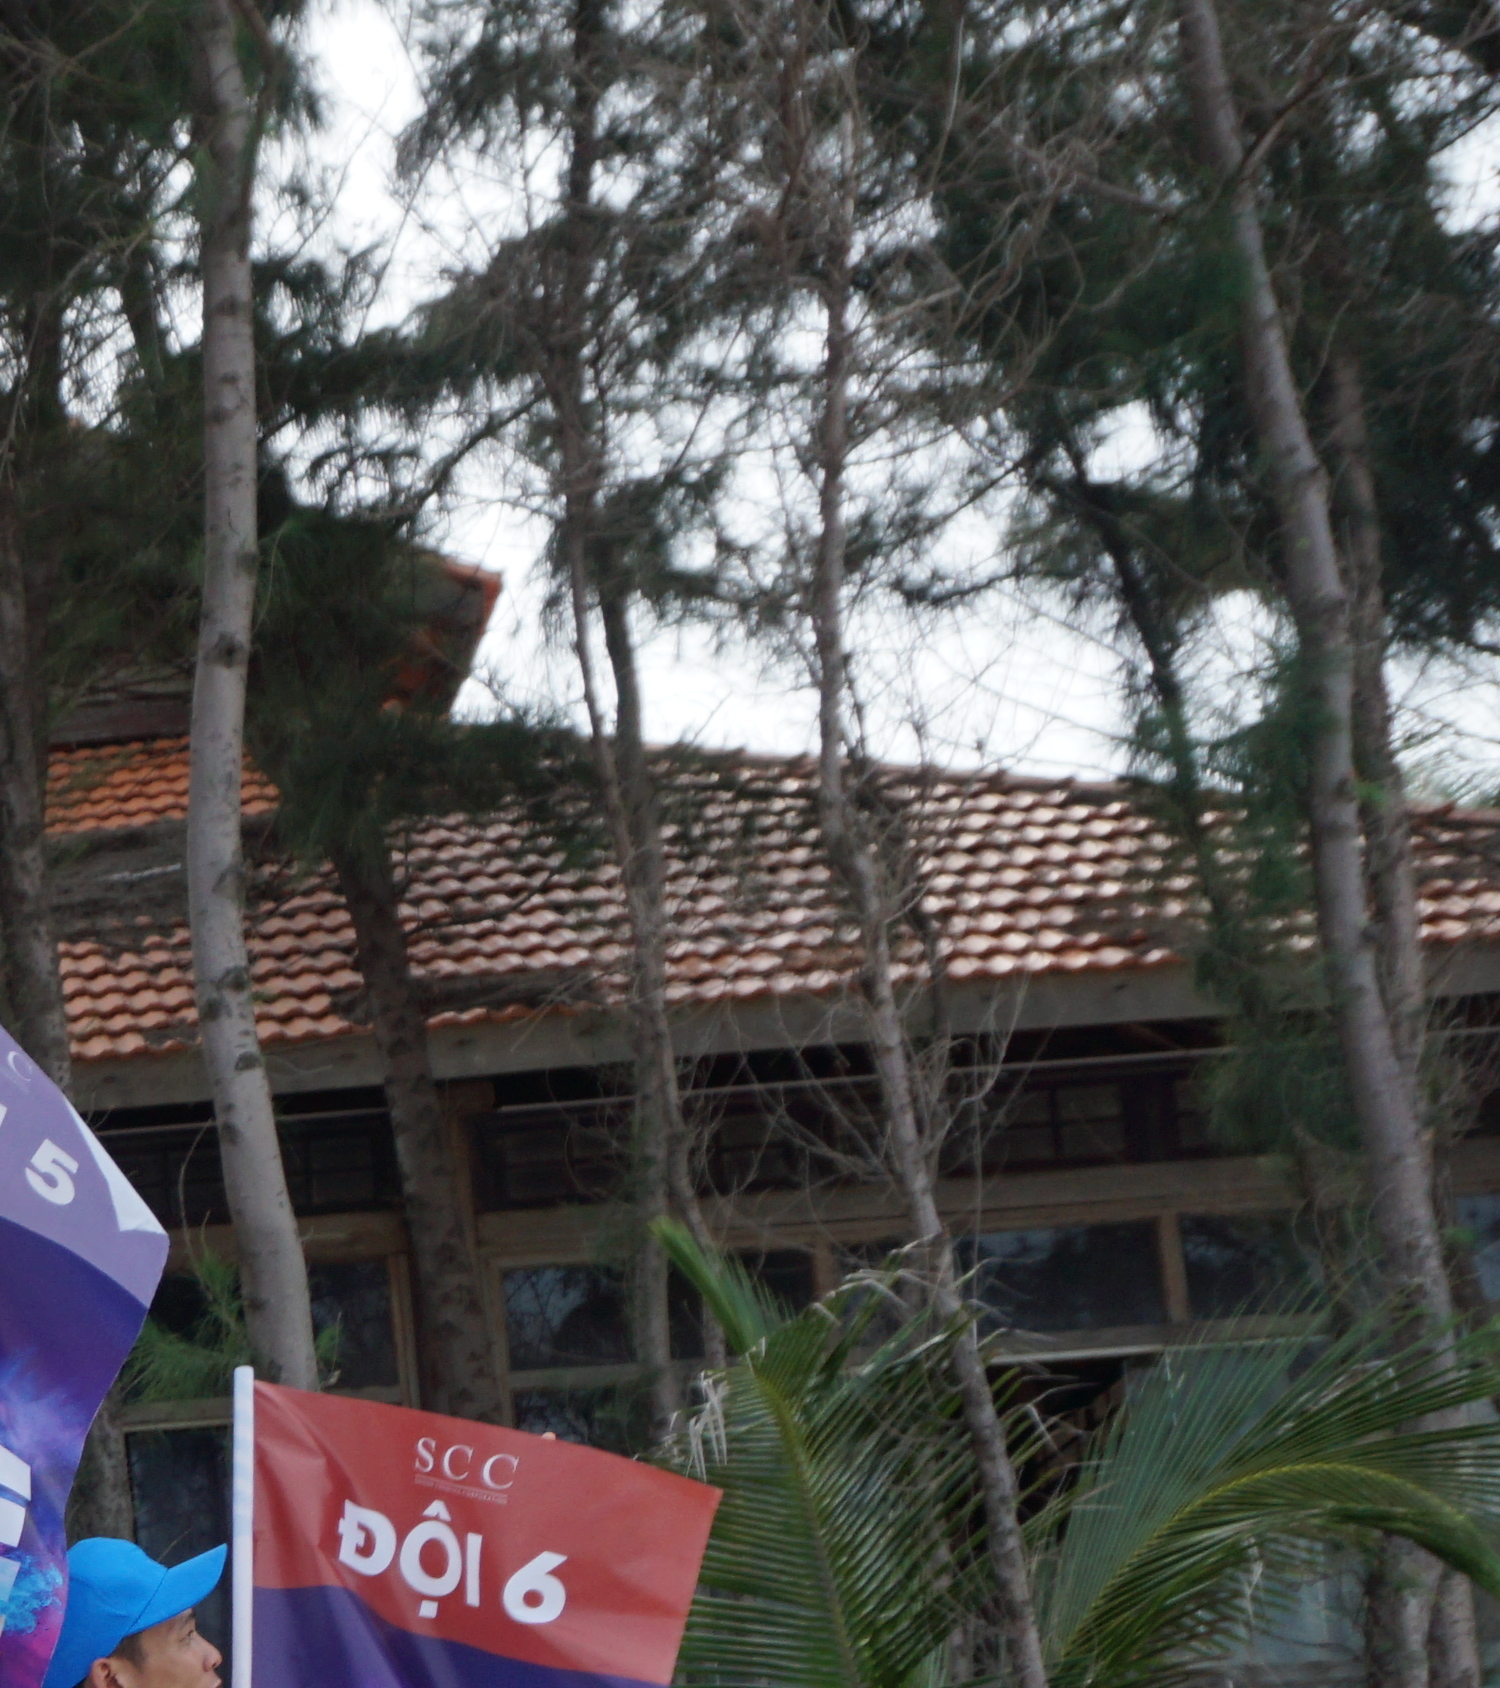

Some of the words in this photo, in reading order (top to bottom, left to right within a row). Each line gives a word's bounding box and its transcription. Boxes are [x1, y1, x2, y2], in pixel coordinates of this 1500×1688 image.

[25, 1138, 79, 1206] 5
[414, 1436, 520, 1490] SCC
[337, 1499, 483, 1618] ĐỘI
[502, 1550, 569, 1625] 6
